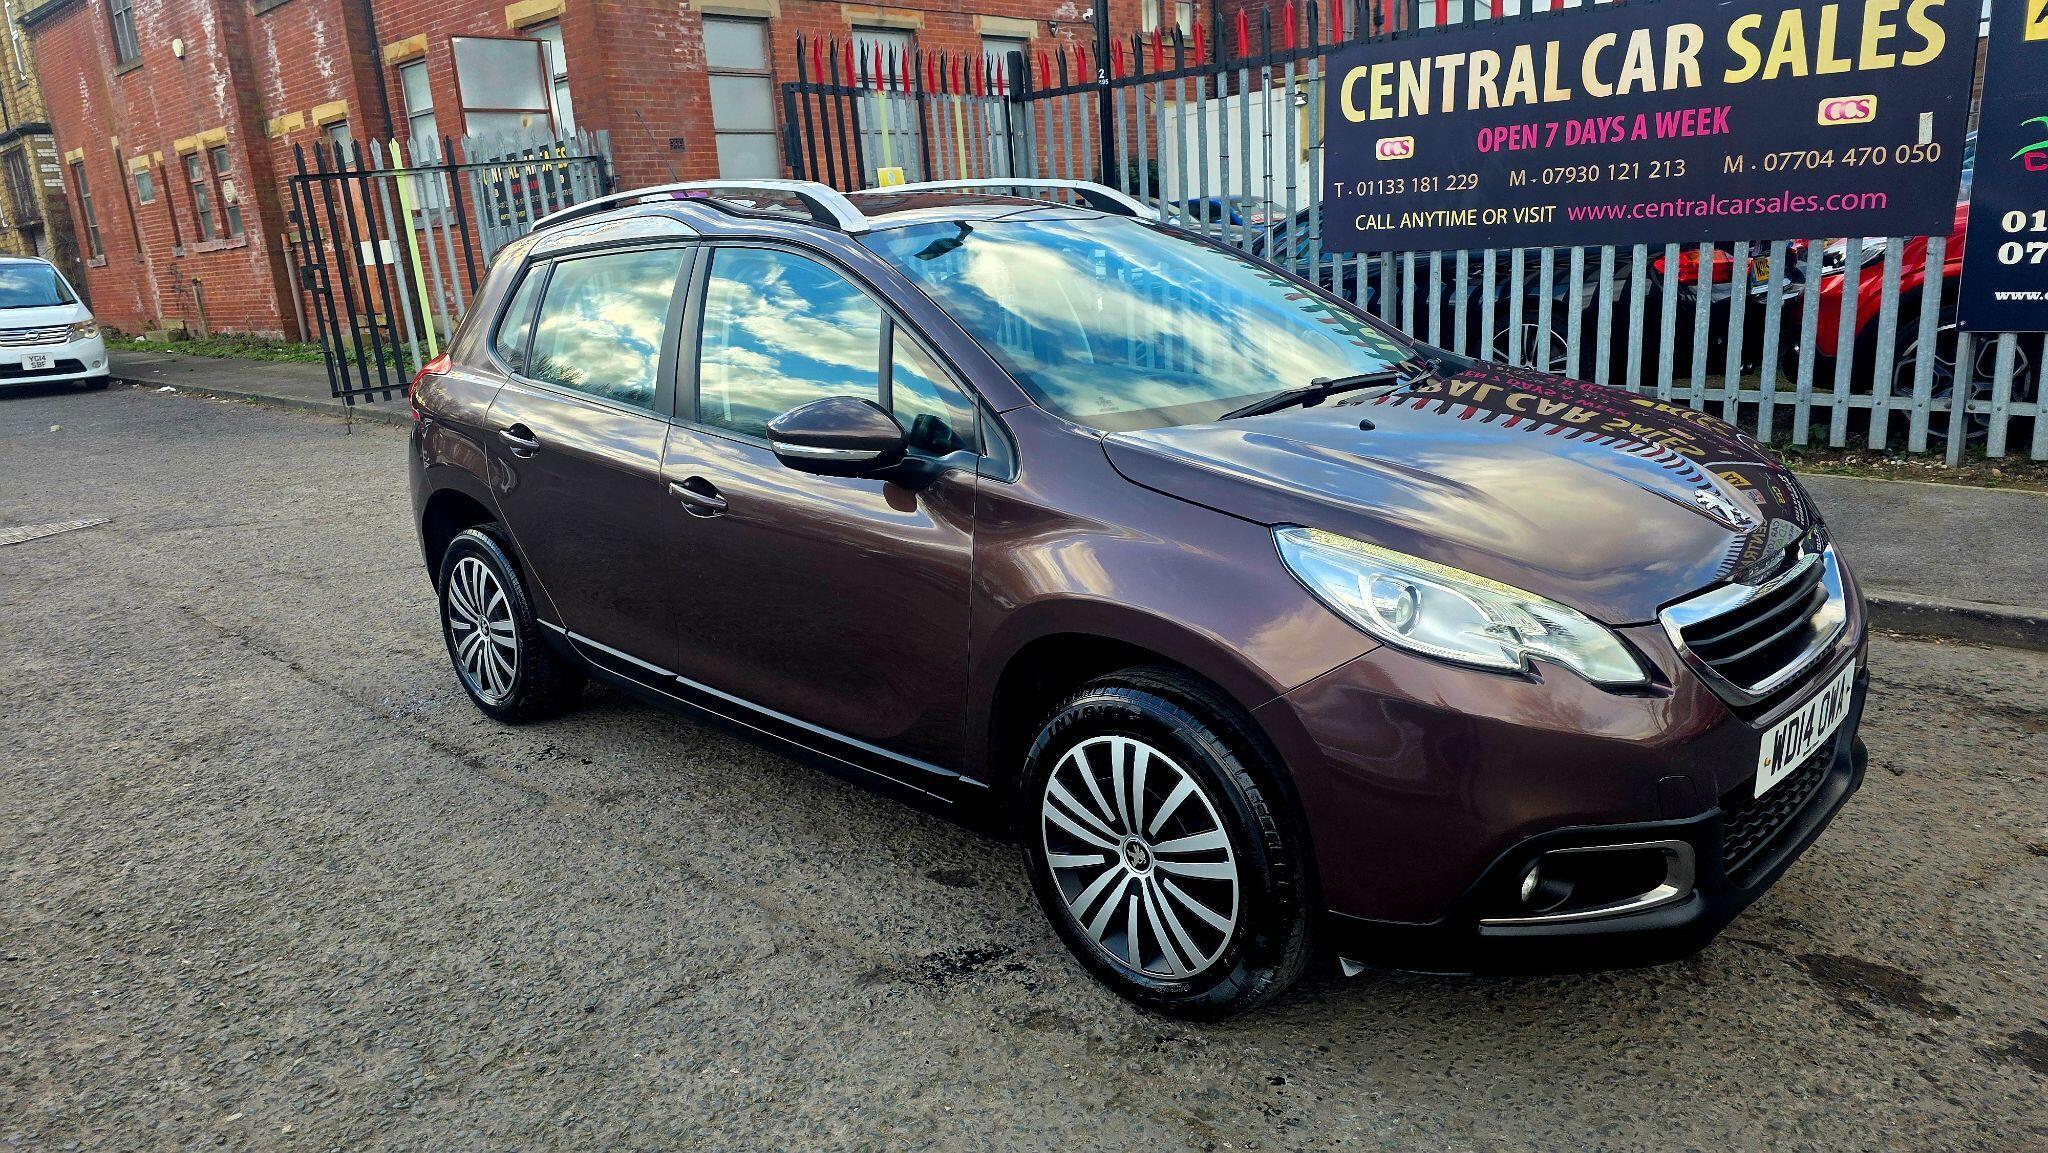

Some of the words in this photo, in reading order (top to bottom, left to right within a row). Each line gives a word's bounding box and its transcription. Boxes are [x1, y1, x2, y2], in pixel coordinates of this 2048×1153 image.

[1340, 40, 1571, 123] CENTRAL
[1581, 23, 1704, 98] CAR
[1723, 0, 1946, 84] SALES
[1824, 98, 1870, 121] CCS
[1477, 123, 1538, 153] OPEN
[1545, 122, 1558, 148] 7
[1565, 115, 1625, 146] DAYS
[1631, 114, 1647, 141] A
[1655, 105, 1732, 139] WEEK
[1380, 139, 1410, 157] CCS
[1763, 148, 1835, 172] 07704
[1842, 146, 1886, 168] 470
[1895, 142, 1941, 164] 050
[1357, 178, 1404, 197] 01133
[1412, 175, 1438, 193] 181
[1445, 173, 1479, 191] 229
[1542, 164, 1600, 185] 07930
[1608, 162, 1639, 181] 121
[1649, 159, 1686, 179] 213
[1355, 214, 1395, 231] CALL
[1399, 208, 1477, 229] ANYTIME
[1482, 207, 1508, 226] OR
[1512, 205, 1557, 224] VISIT
[1567, 190, 1887, 222] www.centralcarsales.com
[1770, 703, 1816, 777] WD14
[1818, 673, 1846, 737] OWA
